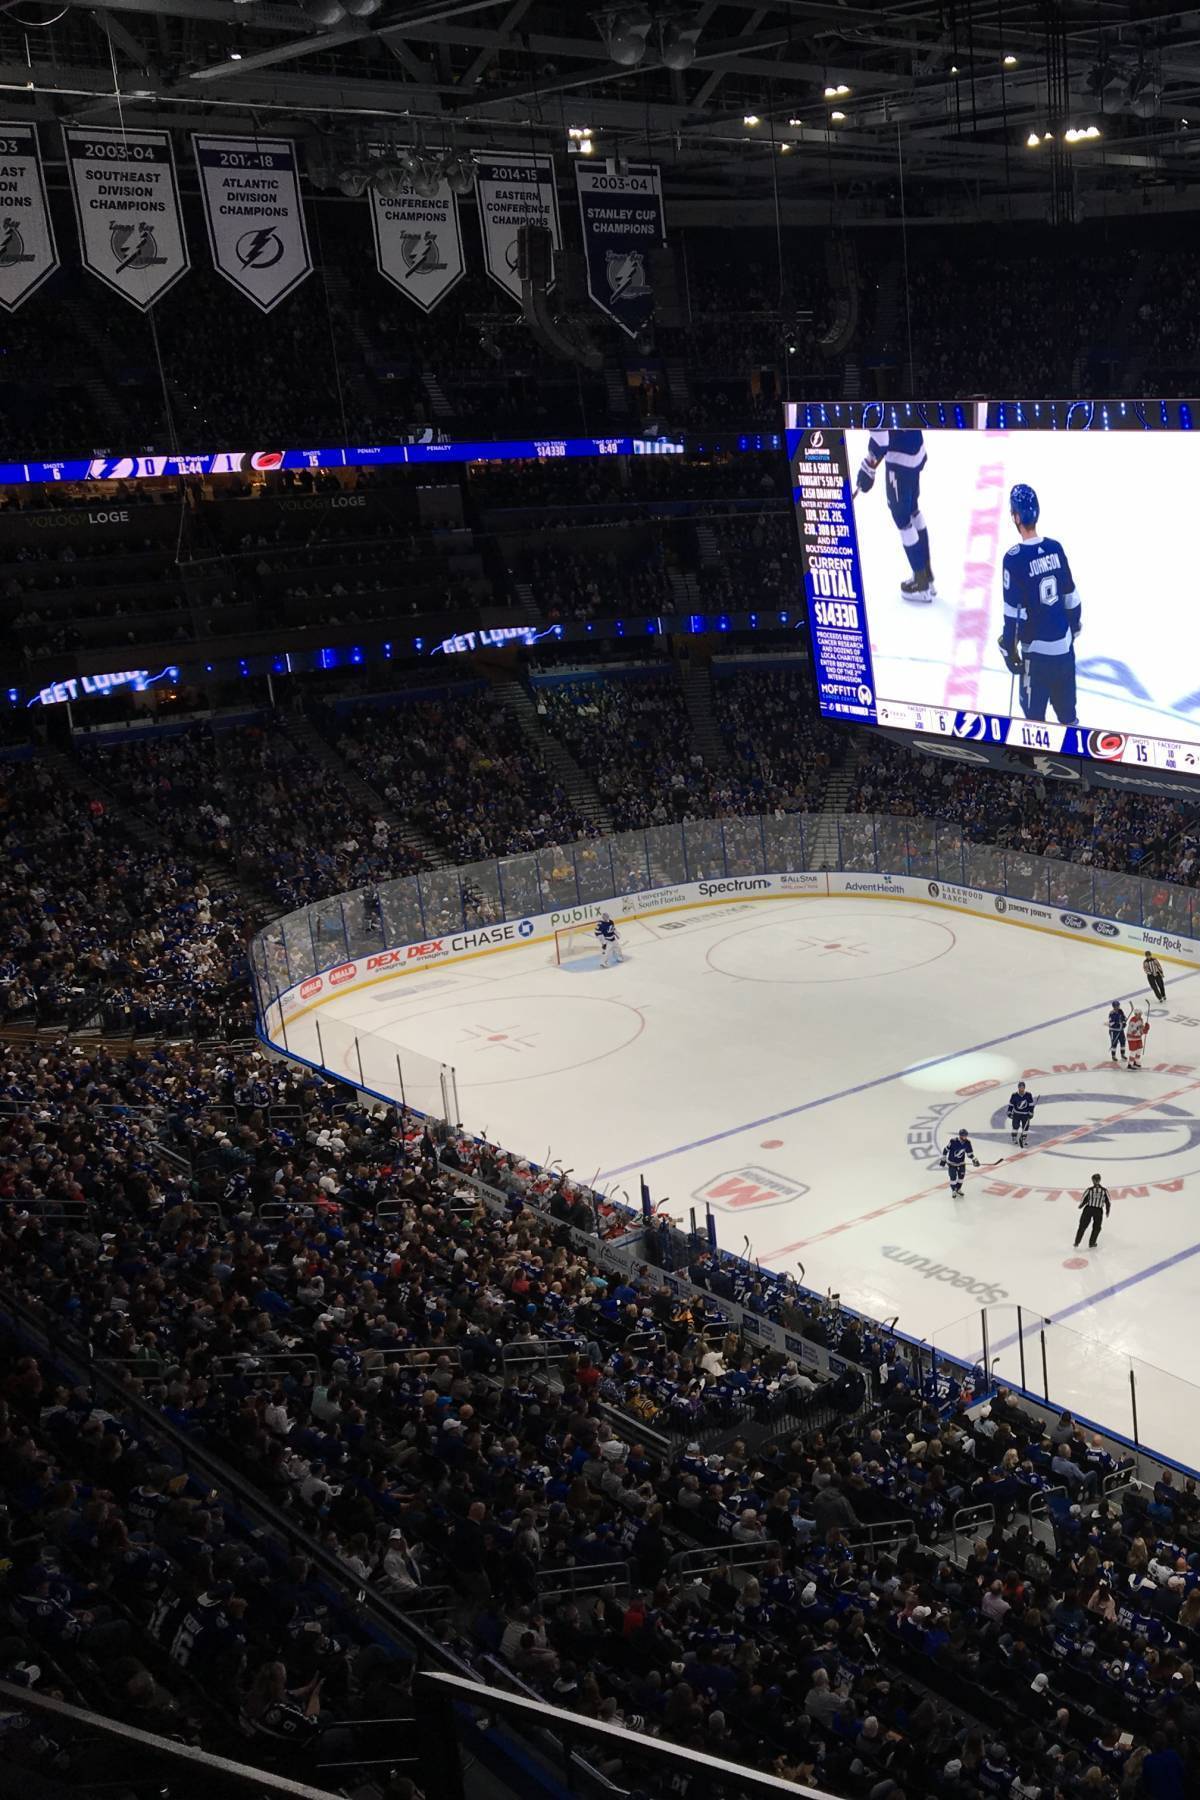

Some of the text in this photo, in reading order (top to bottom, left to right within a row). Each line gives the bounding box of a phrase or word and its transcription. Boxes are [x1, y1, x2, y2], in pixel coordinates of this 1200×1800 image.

[85, 144, 155, 160] 2003-04
[86, 170, 161, 183] SOUTHEAST
[492, 167, 537, 181] 2014-15
[222, 178, 279, 189] ATLANTIC
[592, 176, 648, 191] 2003-04
[98, 185, 152, 197] DIVISION
[227, 192, 277, 203] DIVISION
[495, 191, 539, 201] EASTERN
[90, 199, 165, 212] CHAMPIONS
[379, 198, 449, 209] CONFERENCE
[486, 203, 551, 214] CONFERENCE
[220, 205, 288, 217] CHAMPIONS
[385, 211, 447, 222] CHAMPIONS
[587, 207, 657, 221] STANLEY CUP
[492, 216, 548, 226] CHAMPIONS
[592, 222, 655, 234] CHAMPIONS
[177, 462, 202, 475] 11:44
[310, 456, 319, 467] 15
[331, 495, 366, 508] LOGE
[88, 511, 129, 525] LOGE
[831, 537, 838, 545] AT
[809, 556, 852, 571] CURRENT
[1029, 553, 1061, 577] JOHNSON
[810, 568, 856, 599] TOTAL
[814, 601, 858, 629] $14330
[441, 632, 476, 654] GET
[40, 678, 77, 705] GET
[822, 684, 857, 697] MOFFITT
[939, 716, 946, 731] 6
[991, 718, 1001, 740] 0
[1022, 728, 1050, 748] 11:44
[1076, 730, 1084, 754] 1
[1132, 738, 1149, 746] SHOTS
[1158, 742, 1182, 750] FACEOFF
[1136, 745, 1148, 762] 15
[699, 879, 767, 897] Spectrum
[942, 885, 983, 900] LAKEWOOD
[637, 890, 672, 902] University
[638, 894, 686, 911] South Florida
[942, 893, 968, 905] RANCH
[1008, 903, 1029, 914] JIMMY
[550, 904, 602, 928] Publix
[1063, 914, 1082, 929] Ford
[1096, 923, 1115, 937] Ford
[452, 925, 514, 952] CHASE
[1143, 932, 1182, 953] Hard Rock
[407, 940, 444, 959] DEX
[366, 950, 401, 971] DEX
[889, 1246, 1009, 1305] Spectrum
